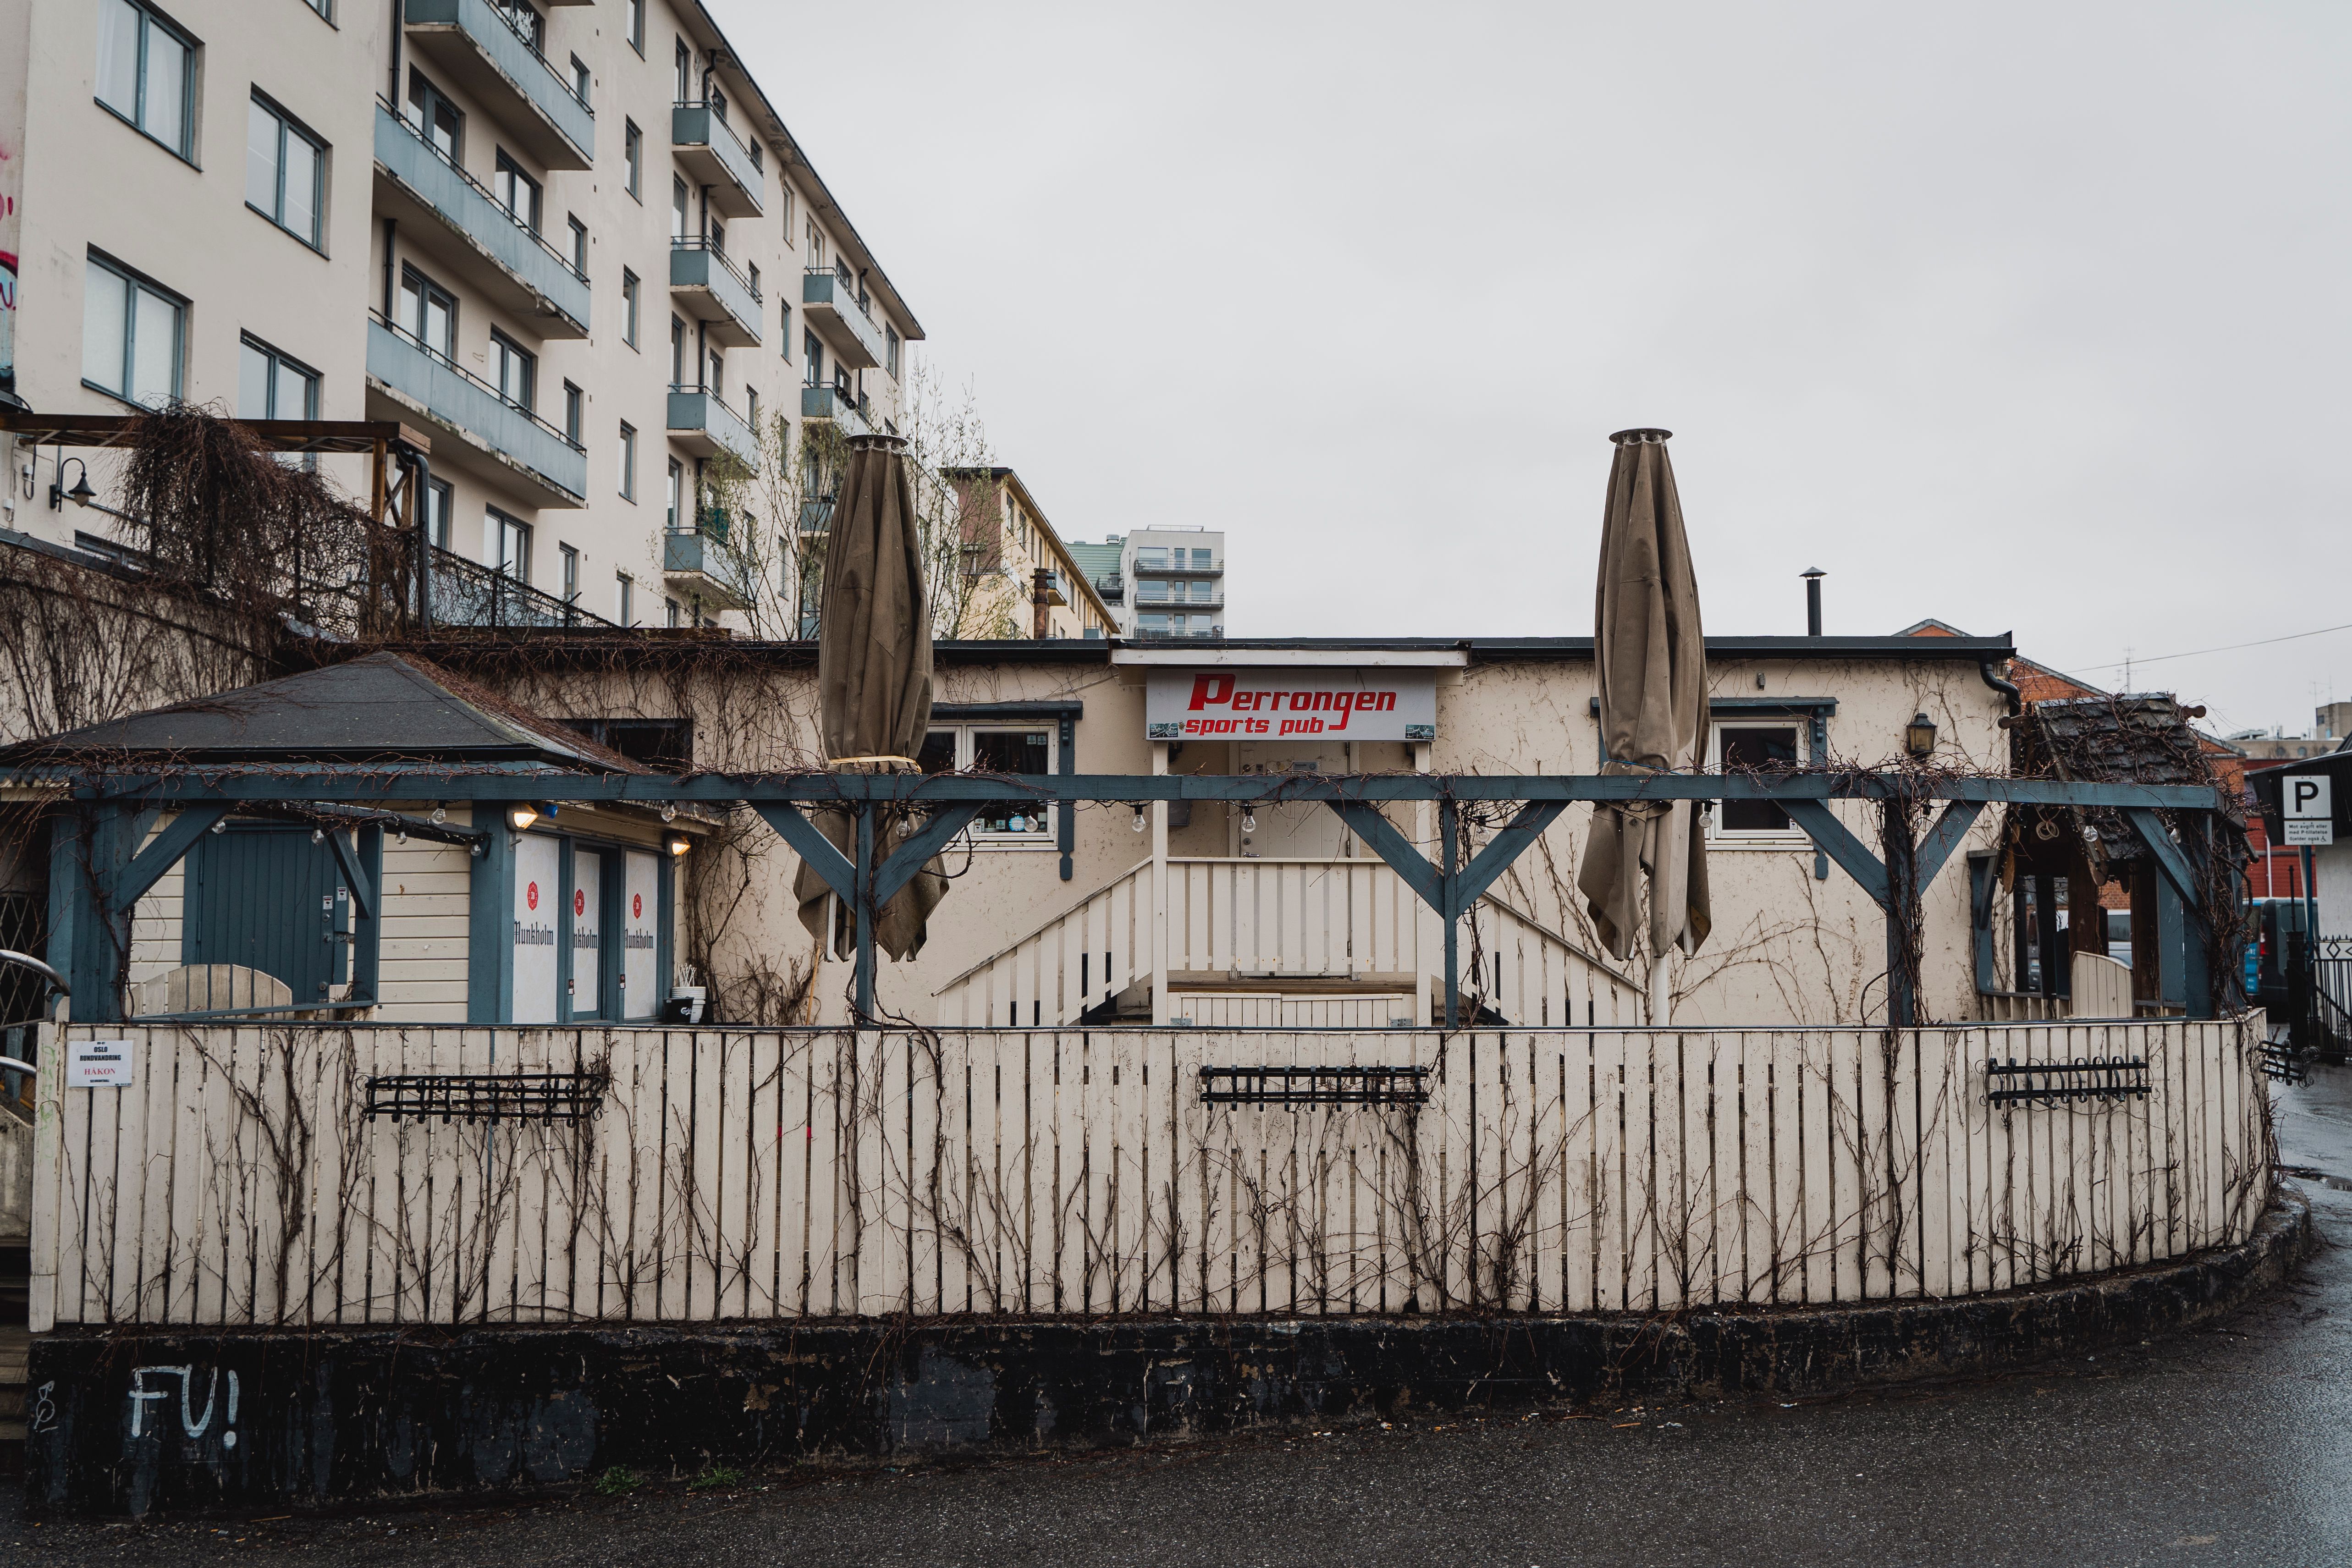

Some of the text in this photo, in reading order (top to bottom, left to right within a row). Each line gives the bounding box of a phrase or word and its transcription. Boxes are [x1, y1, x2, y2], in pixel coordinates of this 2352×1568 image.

[1186, 673, 1397, 731] Perrongen
[1185, 716, 1324, 736] sports pub
[2295, 781, 2319, 813] P
[573, 926, 598, 950] nkholm
[84, 1067, 116, 1075] HÅKON
[128, 1363, 239, 1448] FU!
